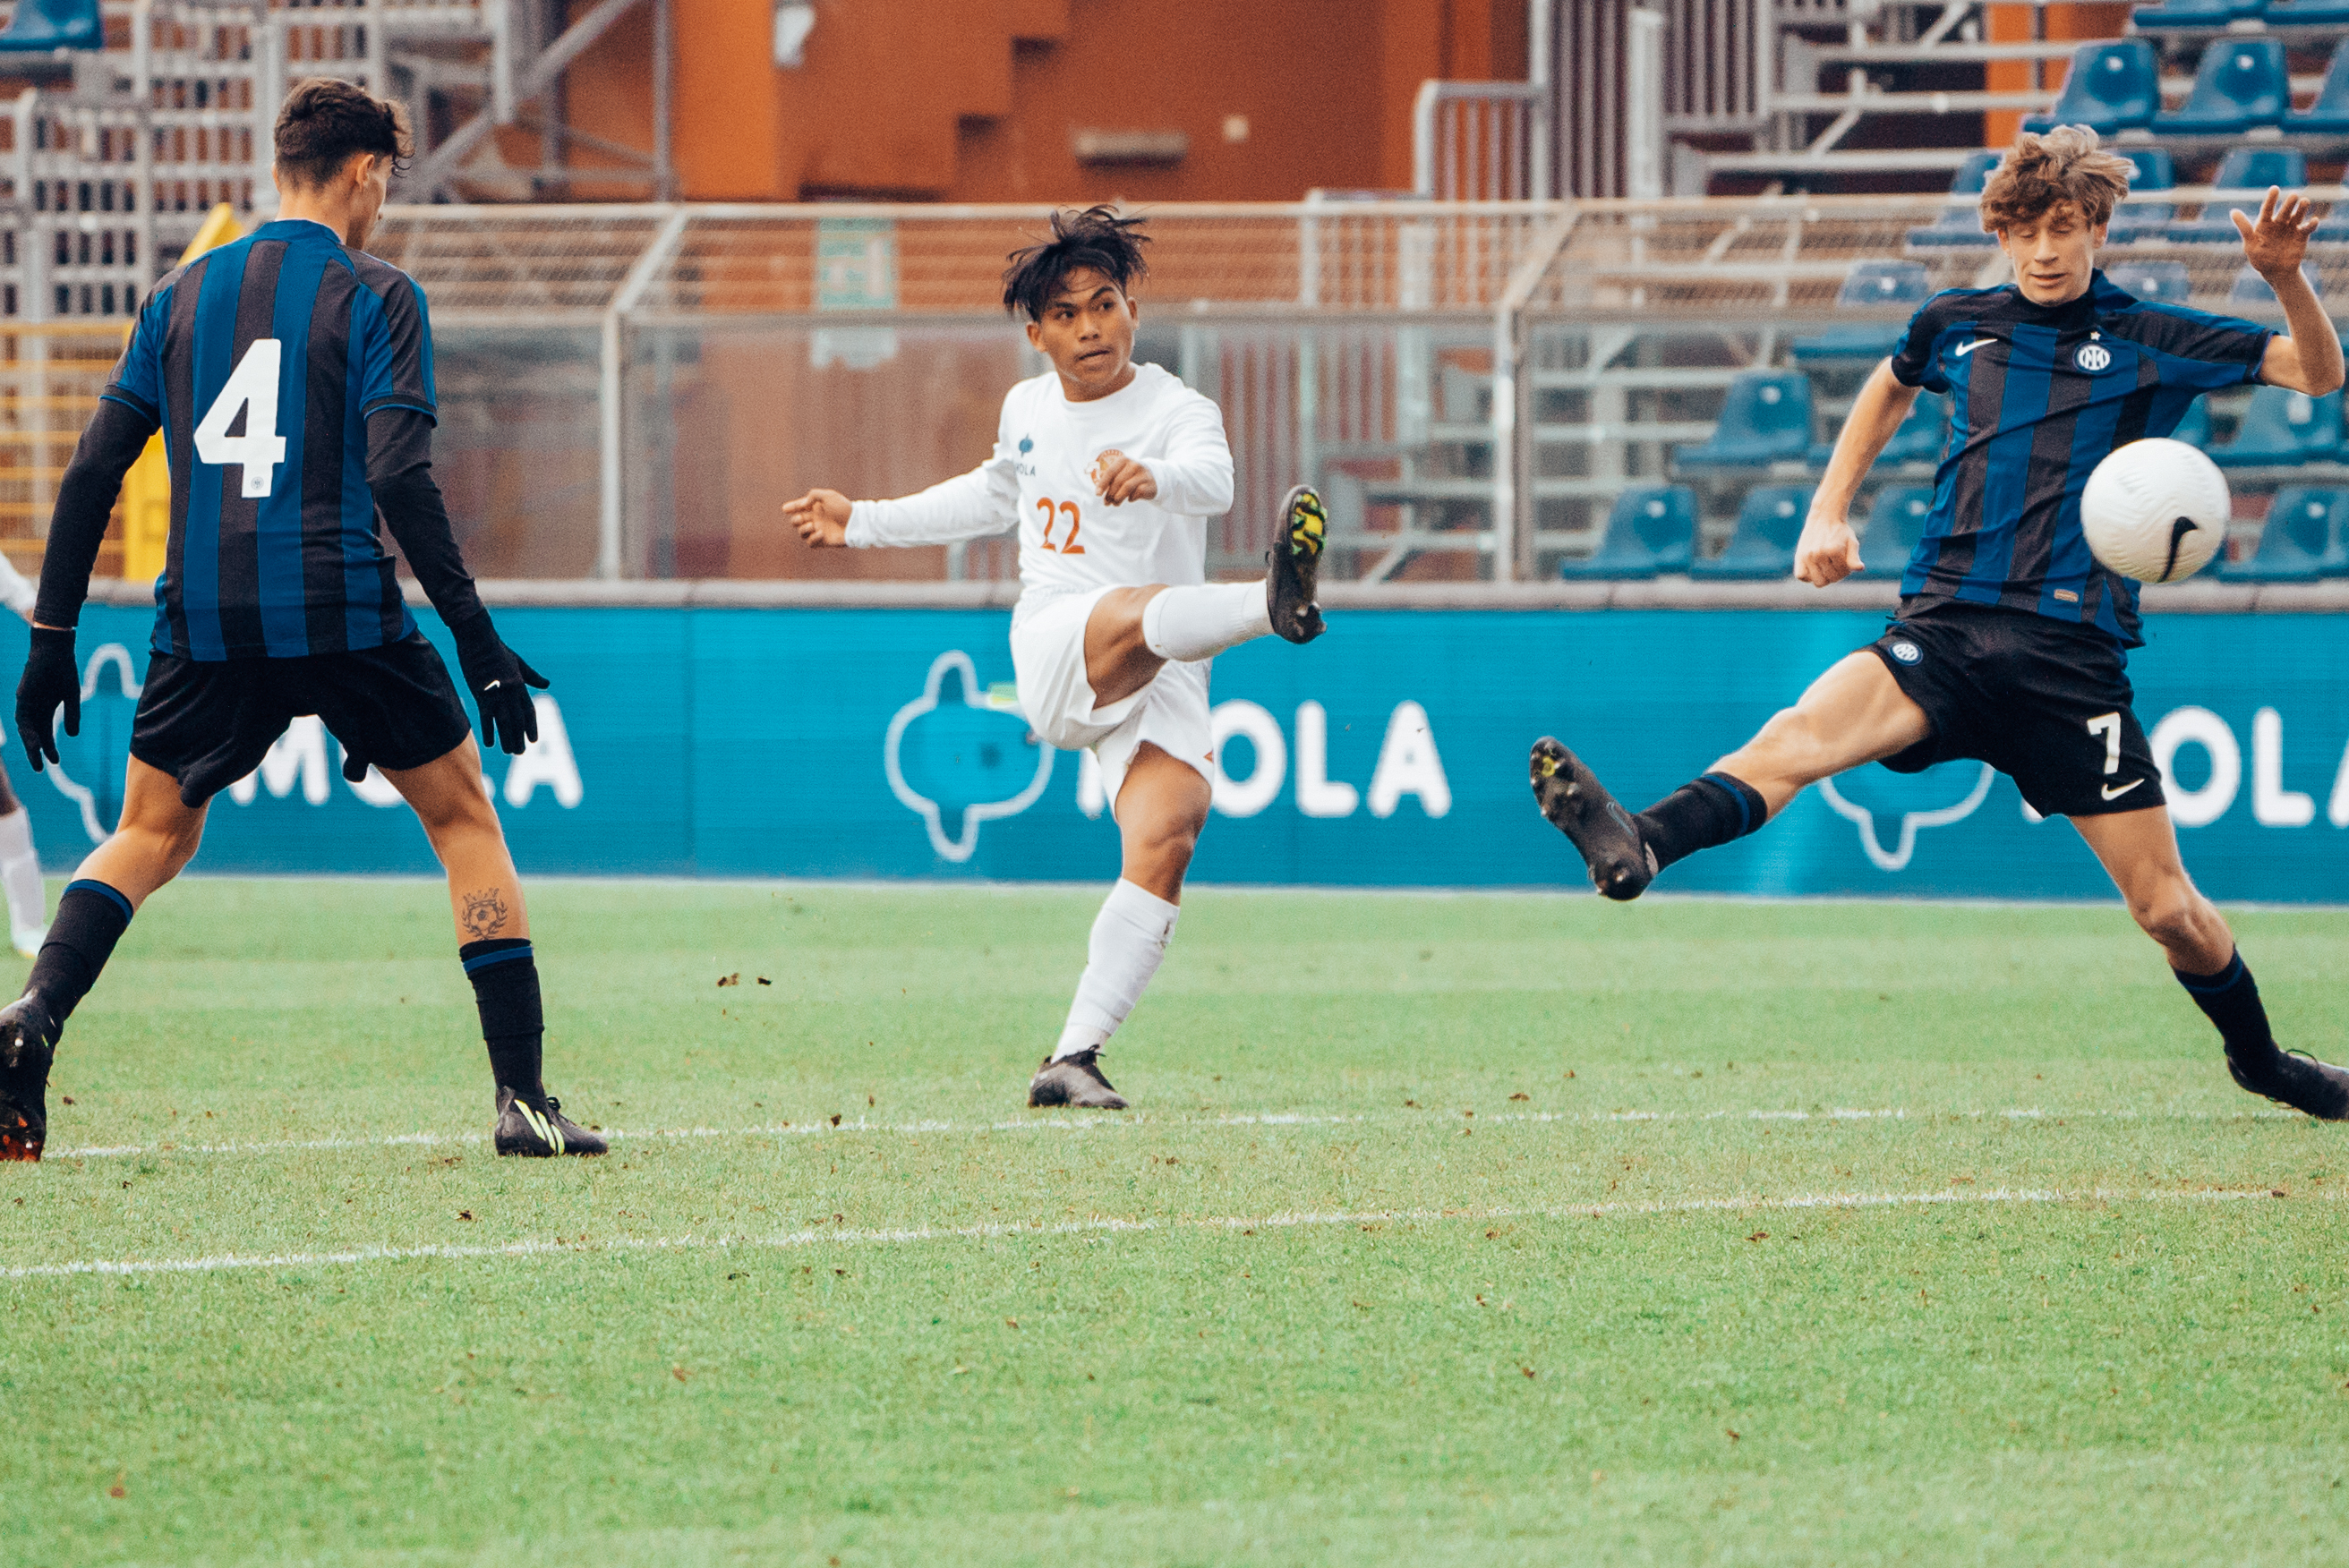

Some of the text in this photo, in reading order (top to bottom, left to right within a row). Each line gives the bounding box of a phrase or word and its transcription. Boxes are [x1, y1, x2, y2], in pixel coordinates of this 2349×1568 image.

[193, 338, 286, 498] 4
[1037, 497, 1085, 554] 22
[1076, 698, 1452, 818] OLA
[2020, 705, 2349, 828] OL
[2087, 712, 2121, 774] 7
